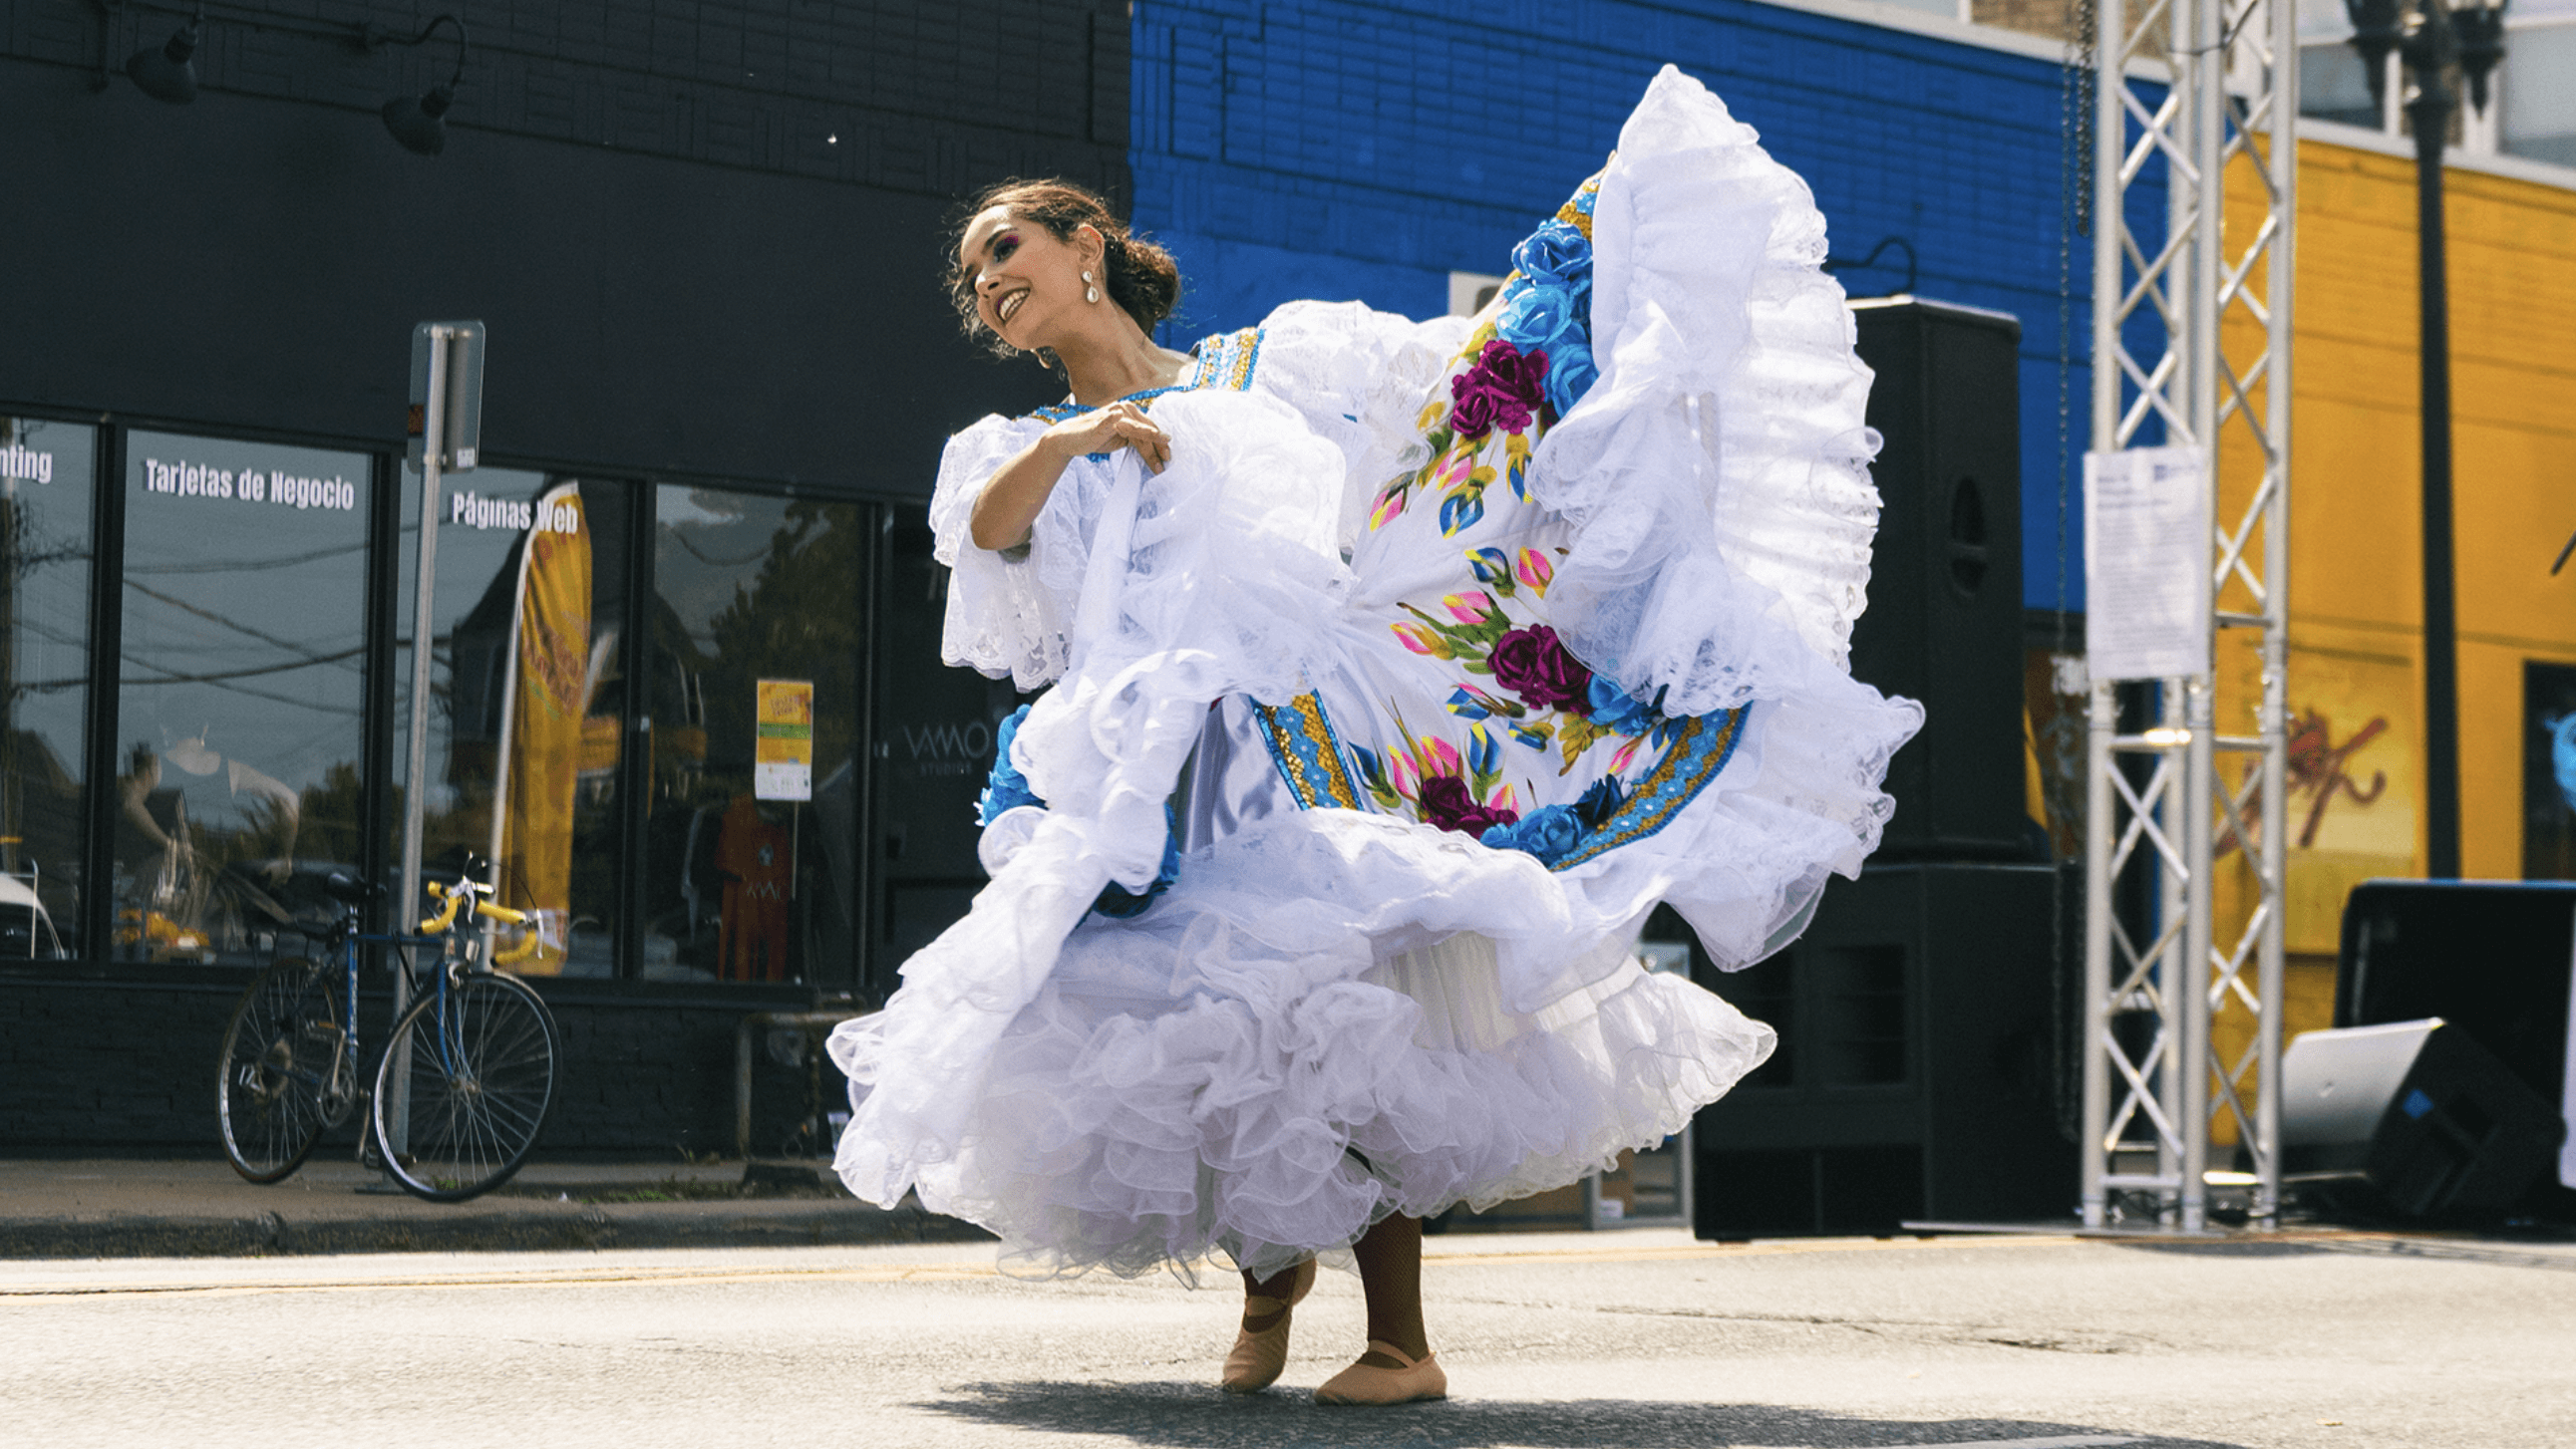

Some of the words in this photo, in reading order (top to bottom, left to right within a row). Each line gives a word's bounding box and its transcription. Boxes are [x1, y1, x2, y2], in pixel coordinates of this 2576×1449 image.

[146, 457, 233, 498] Tarjetas
[238, 467, 265, 501] de
[270, 470, 355, 510] Negocio
[453, 490, 531, 530] Páginas
[536, 499, 578, 534] Web
